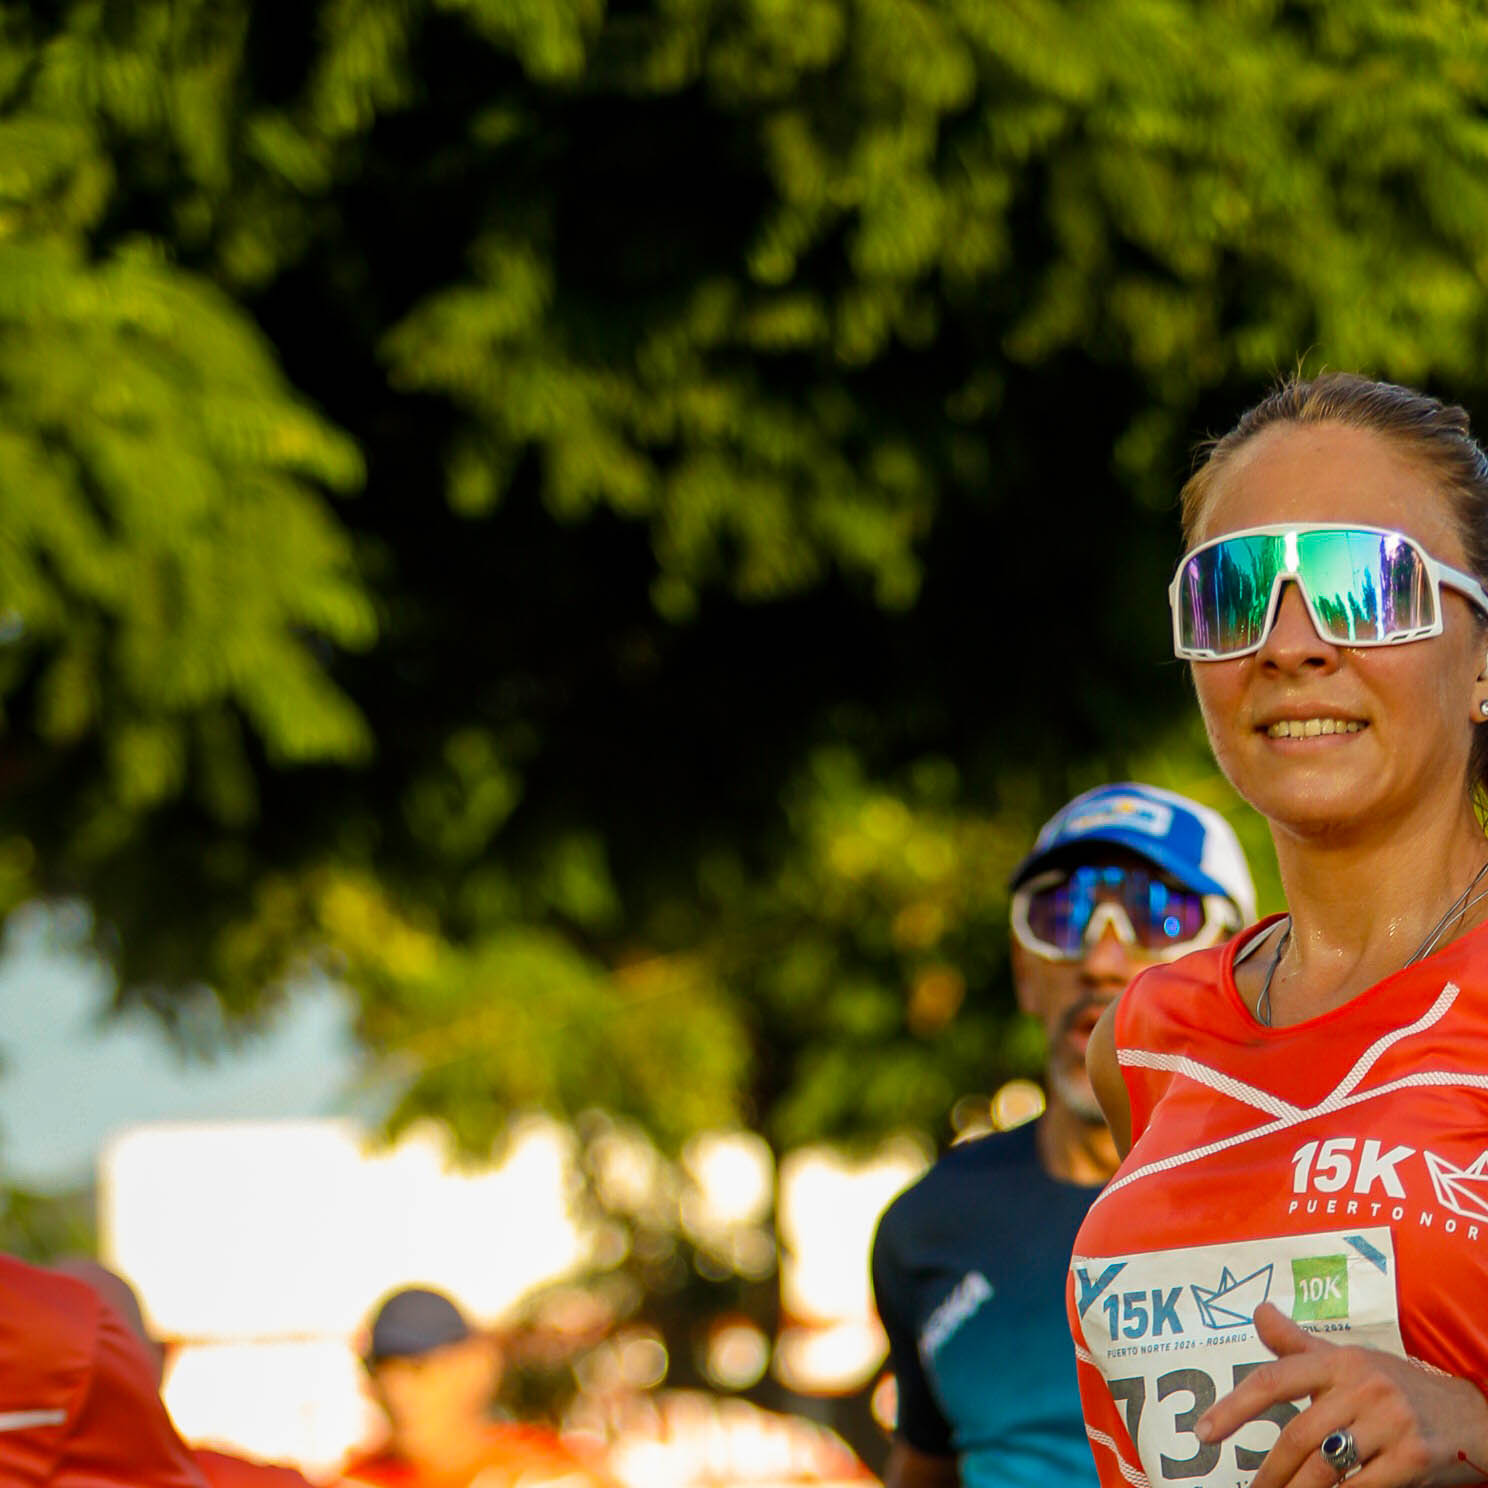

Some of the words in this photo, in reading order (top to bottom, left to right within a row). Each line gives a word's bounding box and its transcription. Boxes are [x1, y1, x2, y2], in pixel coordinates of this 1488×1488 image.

[1291, 1138, 1416, 1199] 15K
[1288, 1199, 1404, 1220] PUERTO
[1299, 1276, 1342, 1304] 10K
[1103, 1286, 1184, 1341] 15K
[1107, 1347, 1138, 1358] PUERTO
[1140, 1342, 1170, 1355] NORTE
[1206, 1333, 1247, 1346] ROSARIO
[1107, 1361, 1300, 1480] 735
